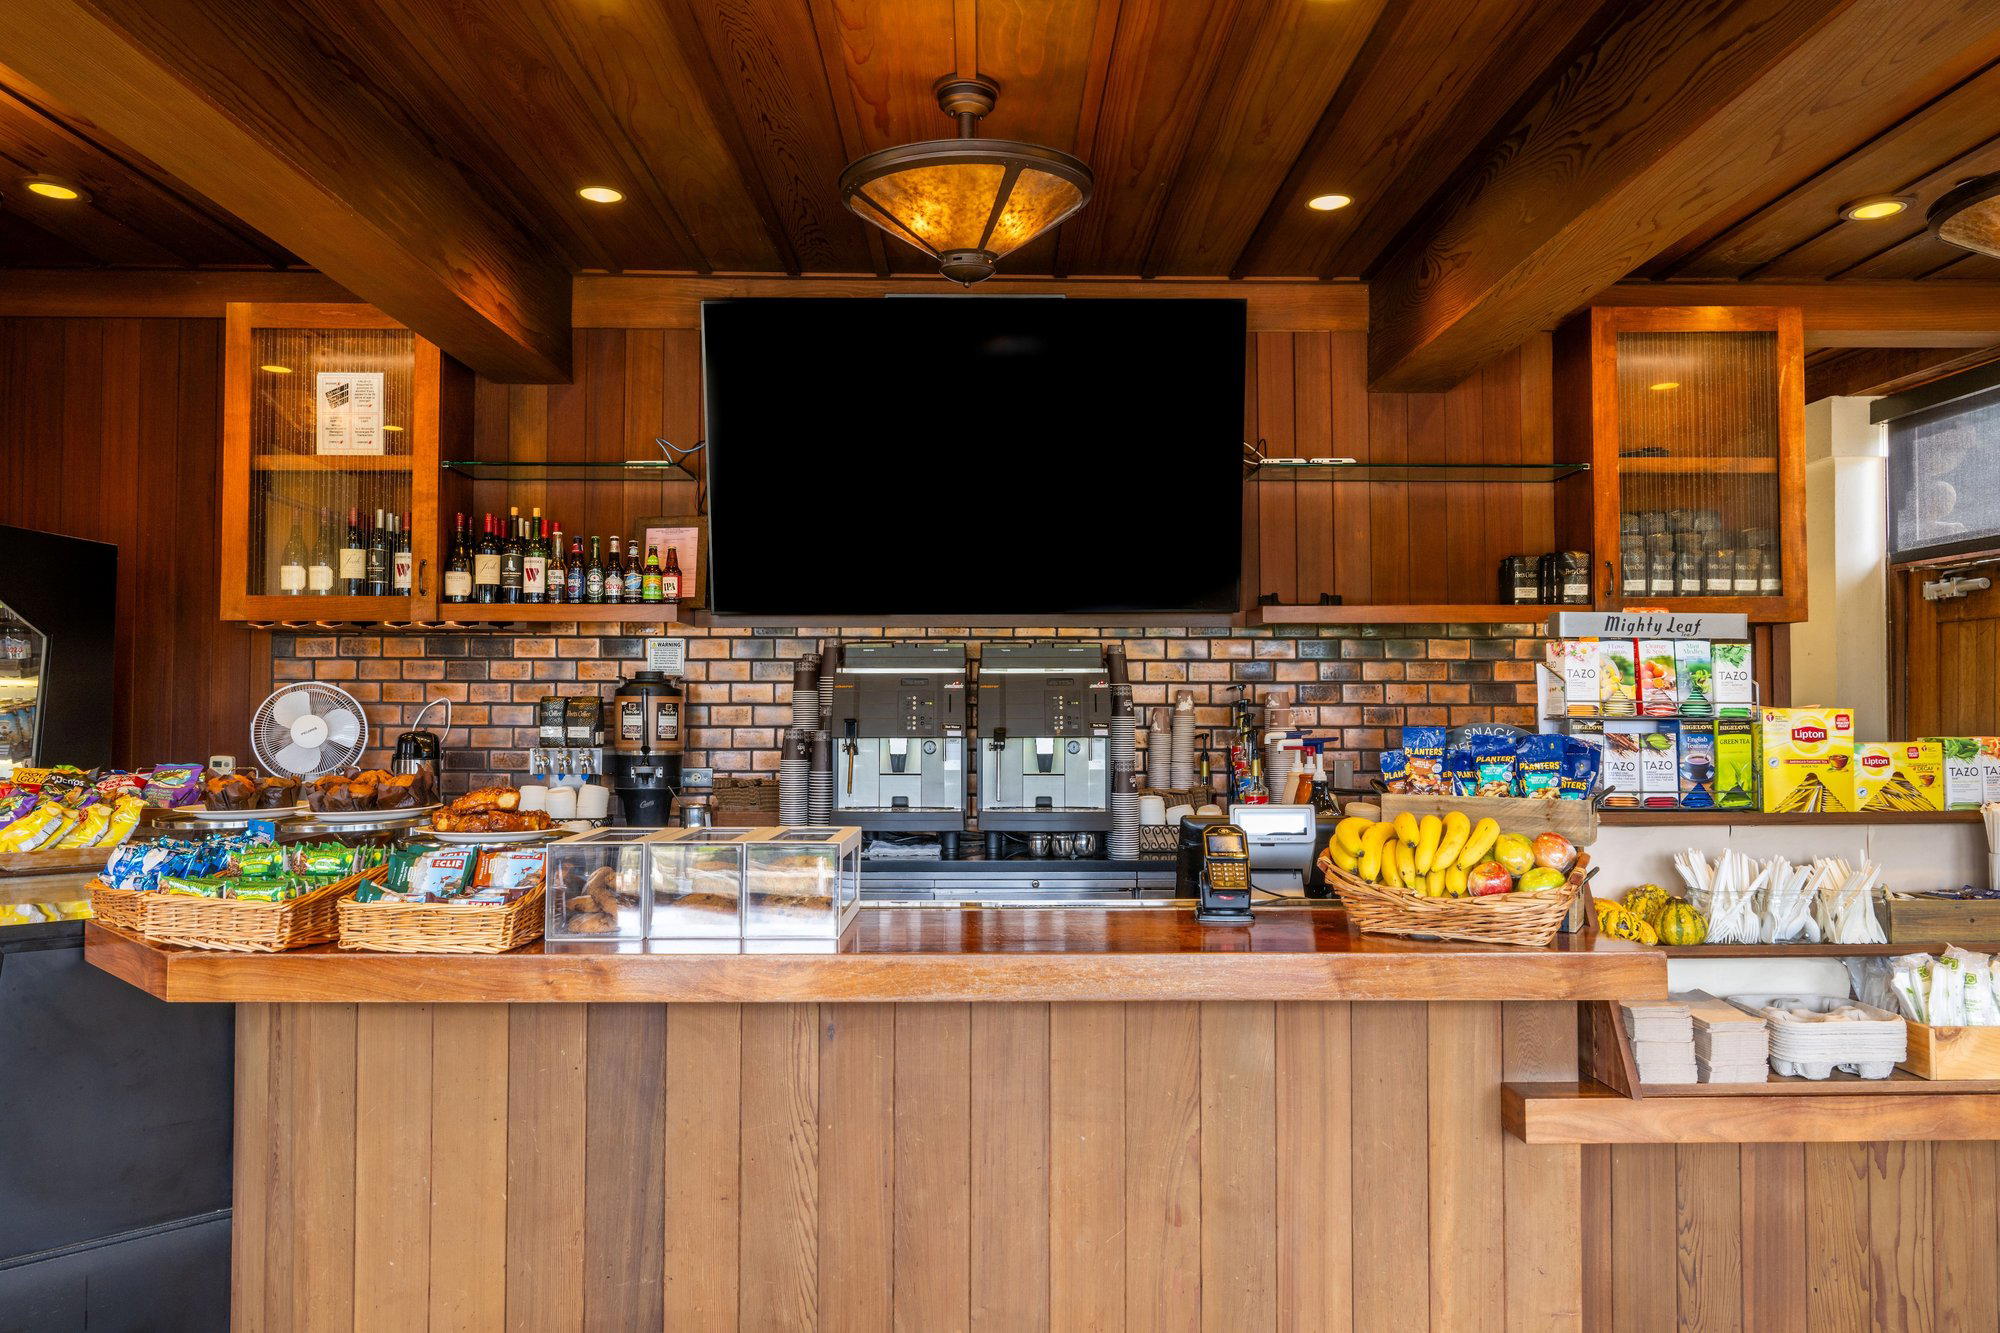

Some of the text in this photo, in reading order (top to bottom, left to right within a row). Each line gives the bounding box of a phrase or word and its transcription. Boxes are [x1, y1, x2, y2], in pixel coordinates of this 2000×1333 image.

[1604, 615, 1703, 637] Mighty Leaf
[1566, 669, 1596, 679] TAZO
[1719, 671, 1748, 681] TAZO
[1794, 730, 1825, 740] Lipton
[1405, 747, 1443, 757] PLANTERS
[1475, 755, 1516, 763] PLANTERS
[1864, 757, 1888, 766] Lipton
[1519, 761, 1561, 771] PLANTERS
[1606, 761, 1635, 771] TAZO
[1644, 760, 1673, 771] TAZO
[1983, 765, 2000, 776] TA
[1949, 766, 1979, 777] TAZO
[1561, 780, 1587, 791] NTERS
[438, 859, 463, 868] CLIF
